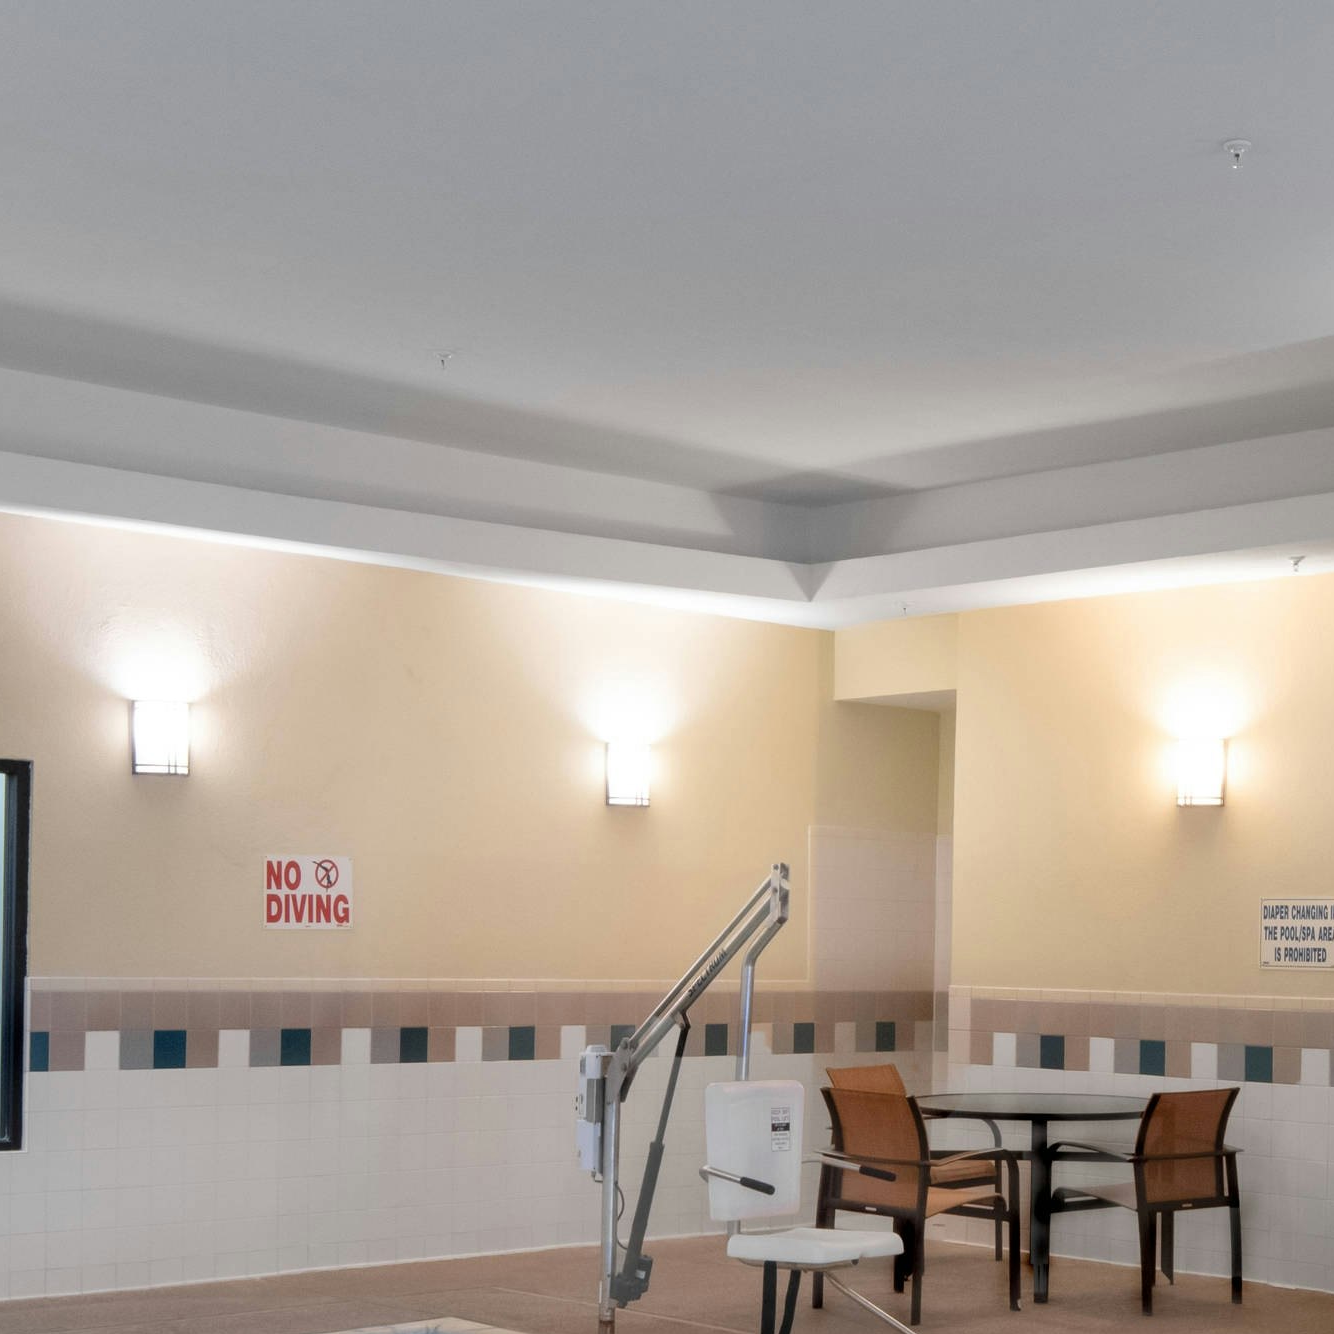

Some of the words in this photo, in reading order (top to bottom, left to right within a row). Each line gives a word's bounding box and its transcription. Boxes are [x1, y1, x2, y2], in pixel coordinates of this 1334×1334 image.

[266, 860, 301, 890] NO
[265, 893, 350, 924] DIVING
[1263, 905, 1289, 920] DIAPER
[1291, 905, 1325, 920] CHANGING
[1264, 926, 1278, 941] THE
[1280, 925, 1315, 943] POOL/SPA
[1274, 947, 1282, 962] IS
[1284, 947, 1327, 963] PROHIBITED
